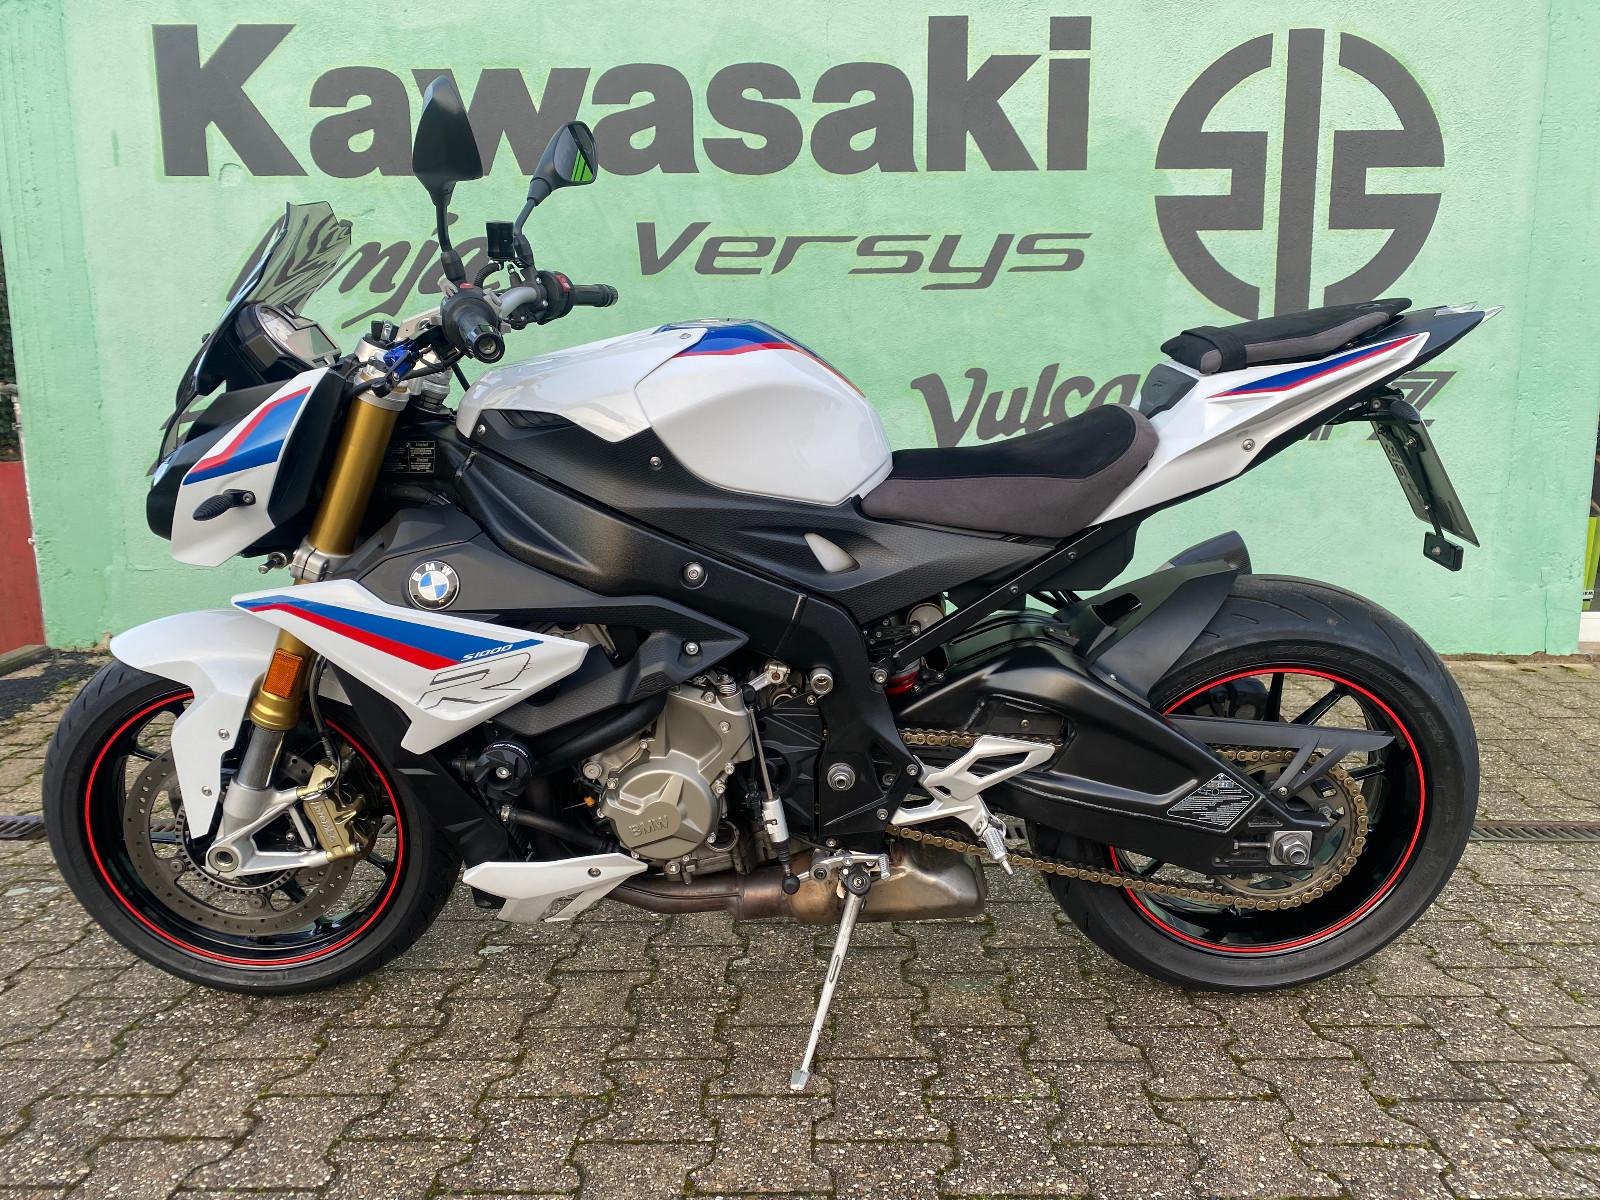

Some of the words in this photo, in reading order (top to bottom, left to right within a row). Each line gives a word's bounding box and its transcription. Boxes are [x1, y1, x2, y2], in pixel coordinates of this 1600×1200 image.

[152, 16, 1092, 178] Kawasaki
[636, 222, 1093, 290] Versys
[910, 362, 1142, 448] Vulca
[461, 644, 514, 661] S1000
[628, 814, 669, 837] BMW
